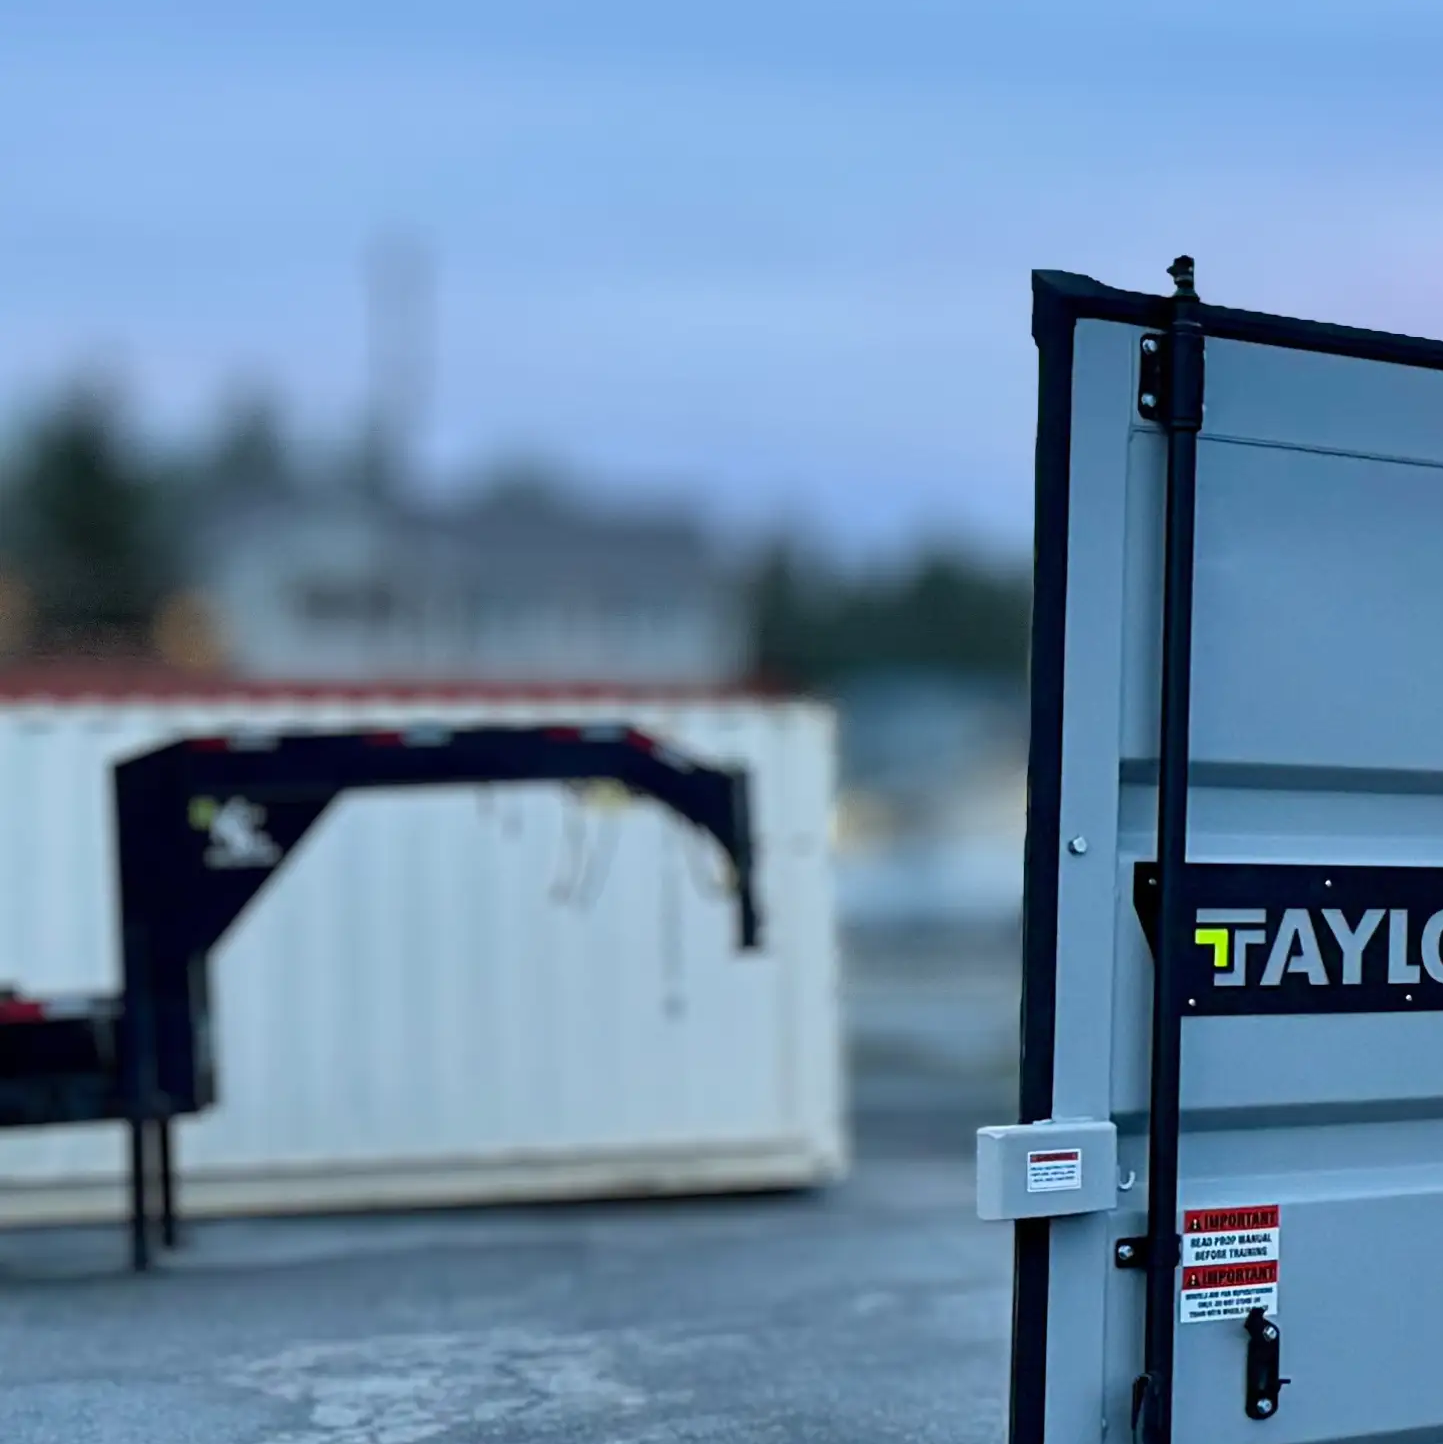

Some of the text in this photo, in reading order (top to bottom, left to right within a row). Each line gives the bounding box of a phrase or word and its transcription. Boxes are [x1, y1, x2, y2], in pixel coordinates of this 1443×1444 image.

[1204, 1212, 1275, 1231] IMPORTANT
[1190, 1236, 1212, 1248] READ
[1238, 1233, 1272, 1244] MANUAL
[1194, 1246, 1268, 1261] BEFORE TRAINING
[1202, 1267, 1274, 1286] IMPORTANT
